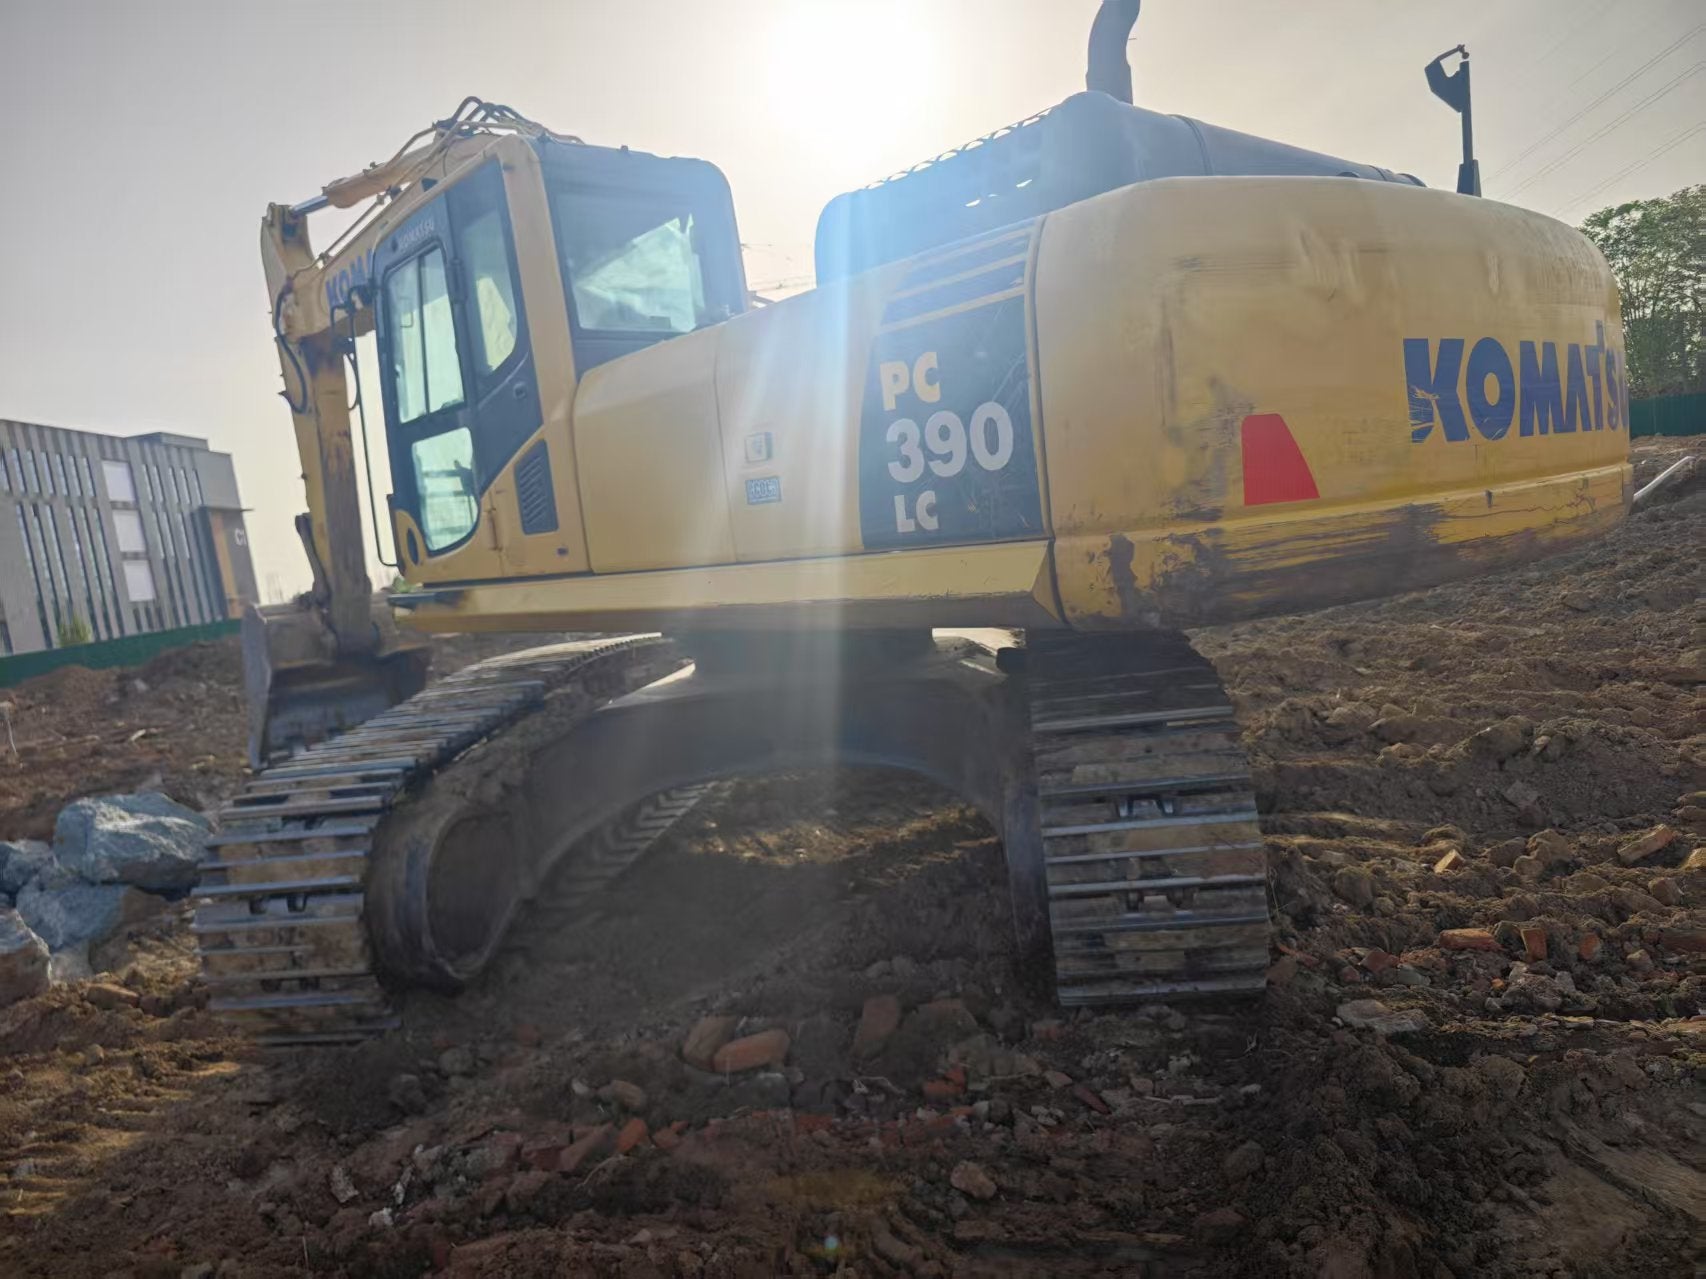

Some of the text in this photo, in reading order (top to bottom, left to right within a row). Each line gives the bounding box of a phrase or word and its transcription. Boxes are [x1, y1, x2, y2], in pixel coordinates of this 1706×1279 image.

[880, 351, 941, 411] PC
[886, 401, 1014, 483] 390
[894, 490, 939, 533] LC
